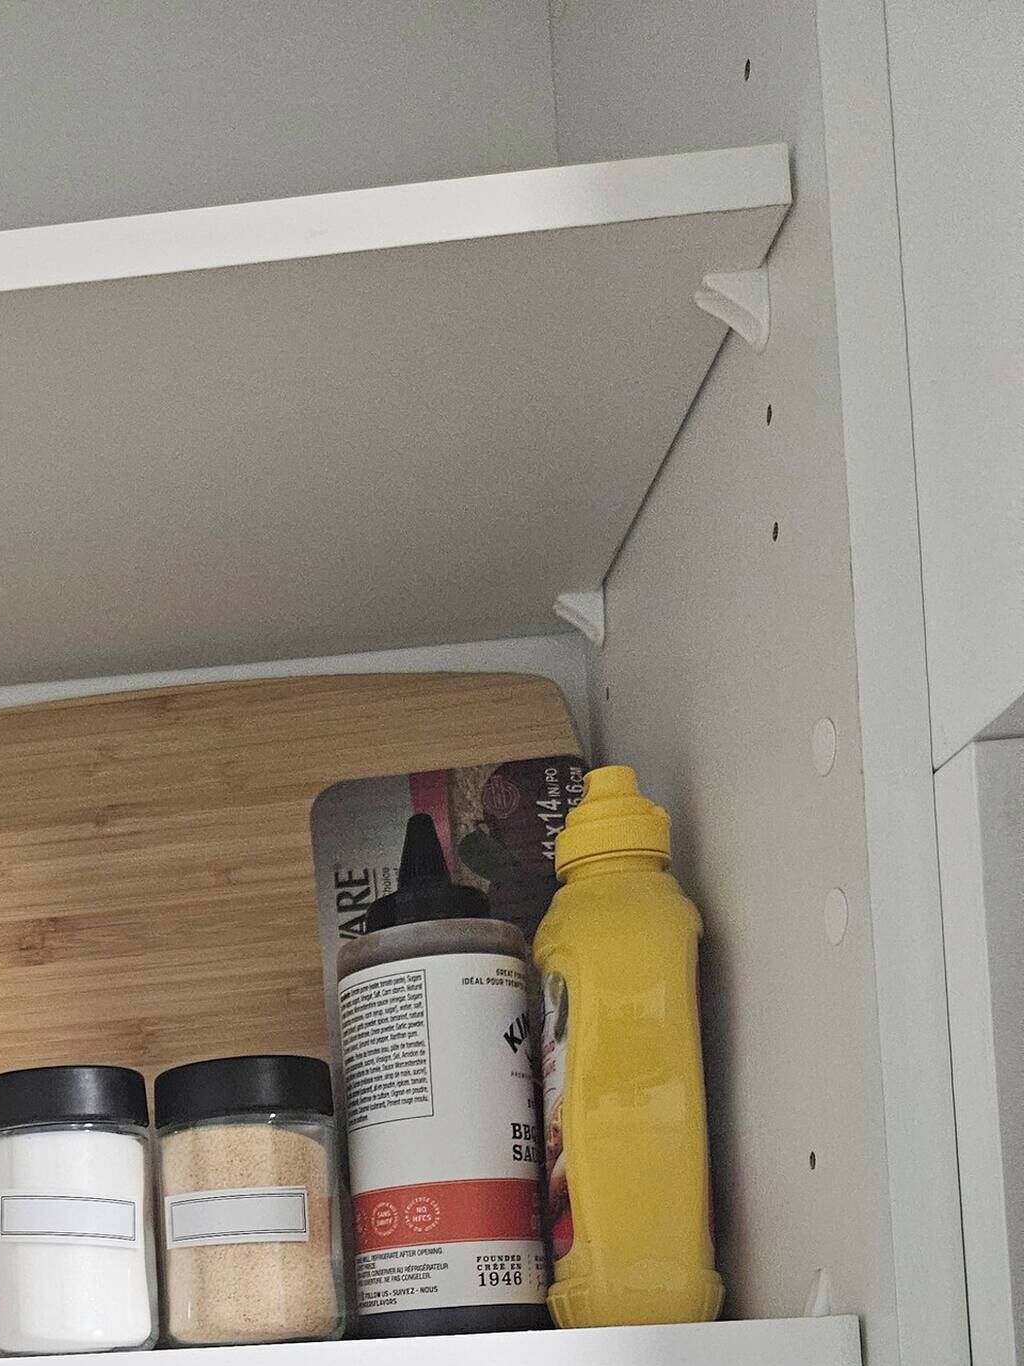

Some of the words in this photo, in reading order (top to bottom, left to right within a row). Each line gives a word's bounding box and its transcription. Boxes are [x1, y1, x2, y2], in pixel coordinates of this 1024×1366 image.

[462, 976, 484, 985] IDÉAL
[476, 1255, 522, 1263] FOUNDED
[478, 1271, 523, 1287] 1946
[420, 1285, 438, 1295] NOUS
